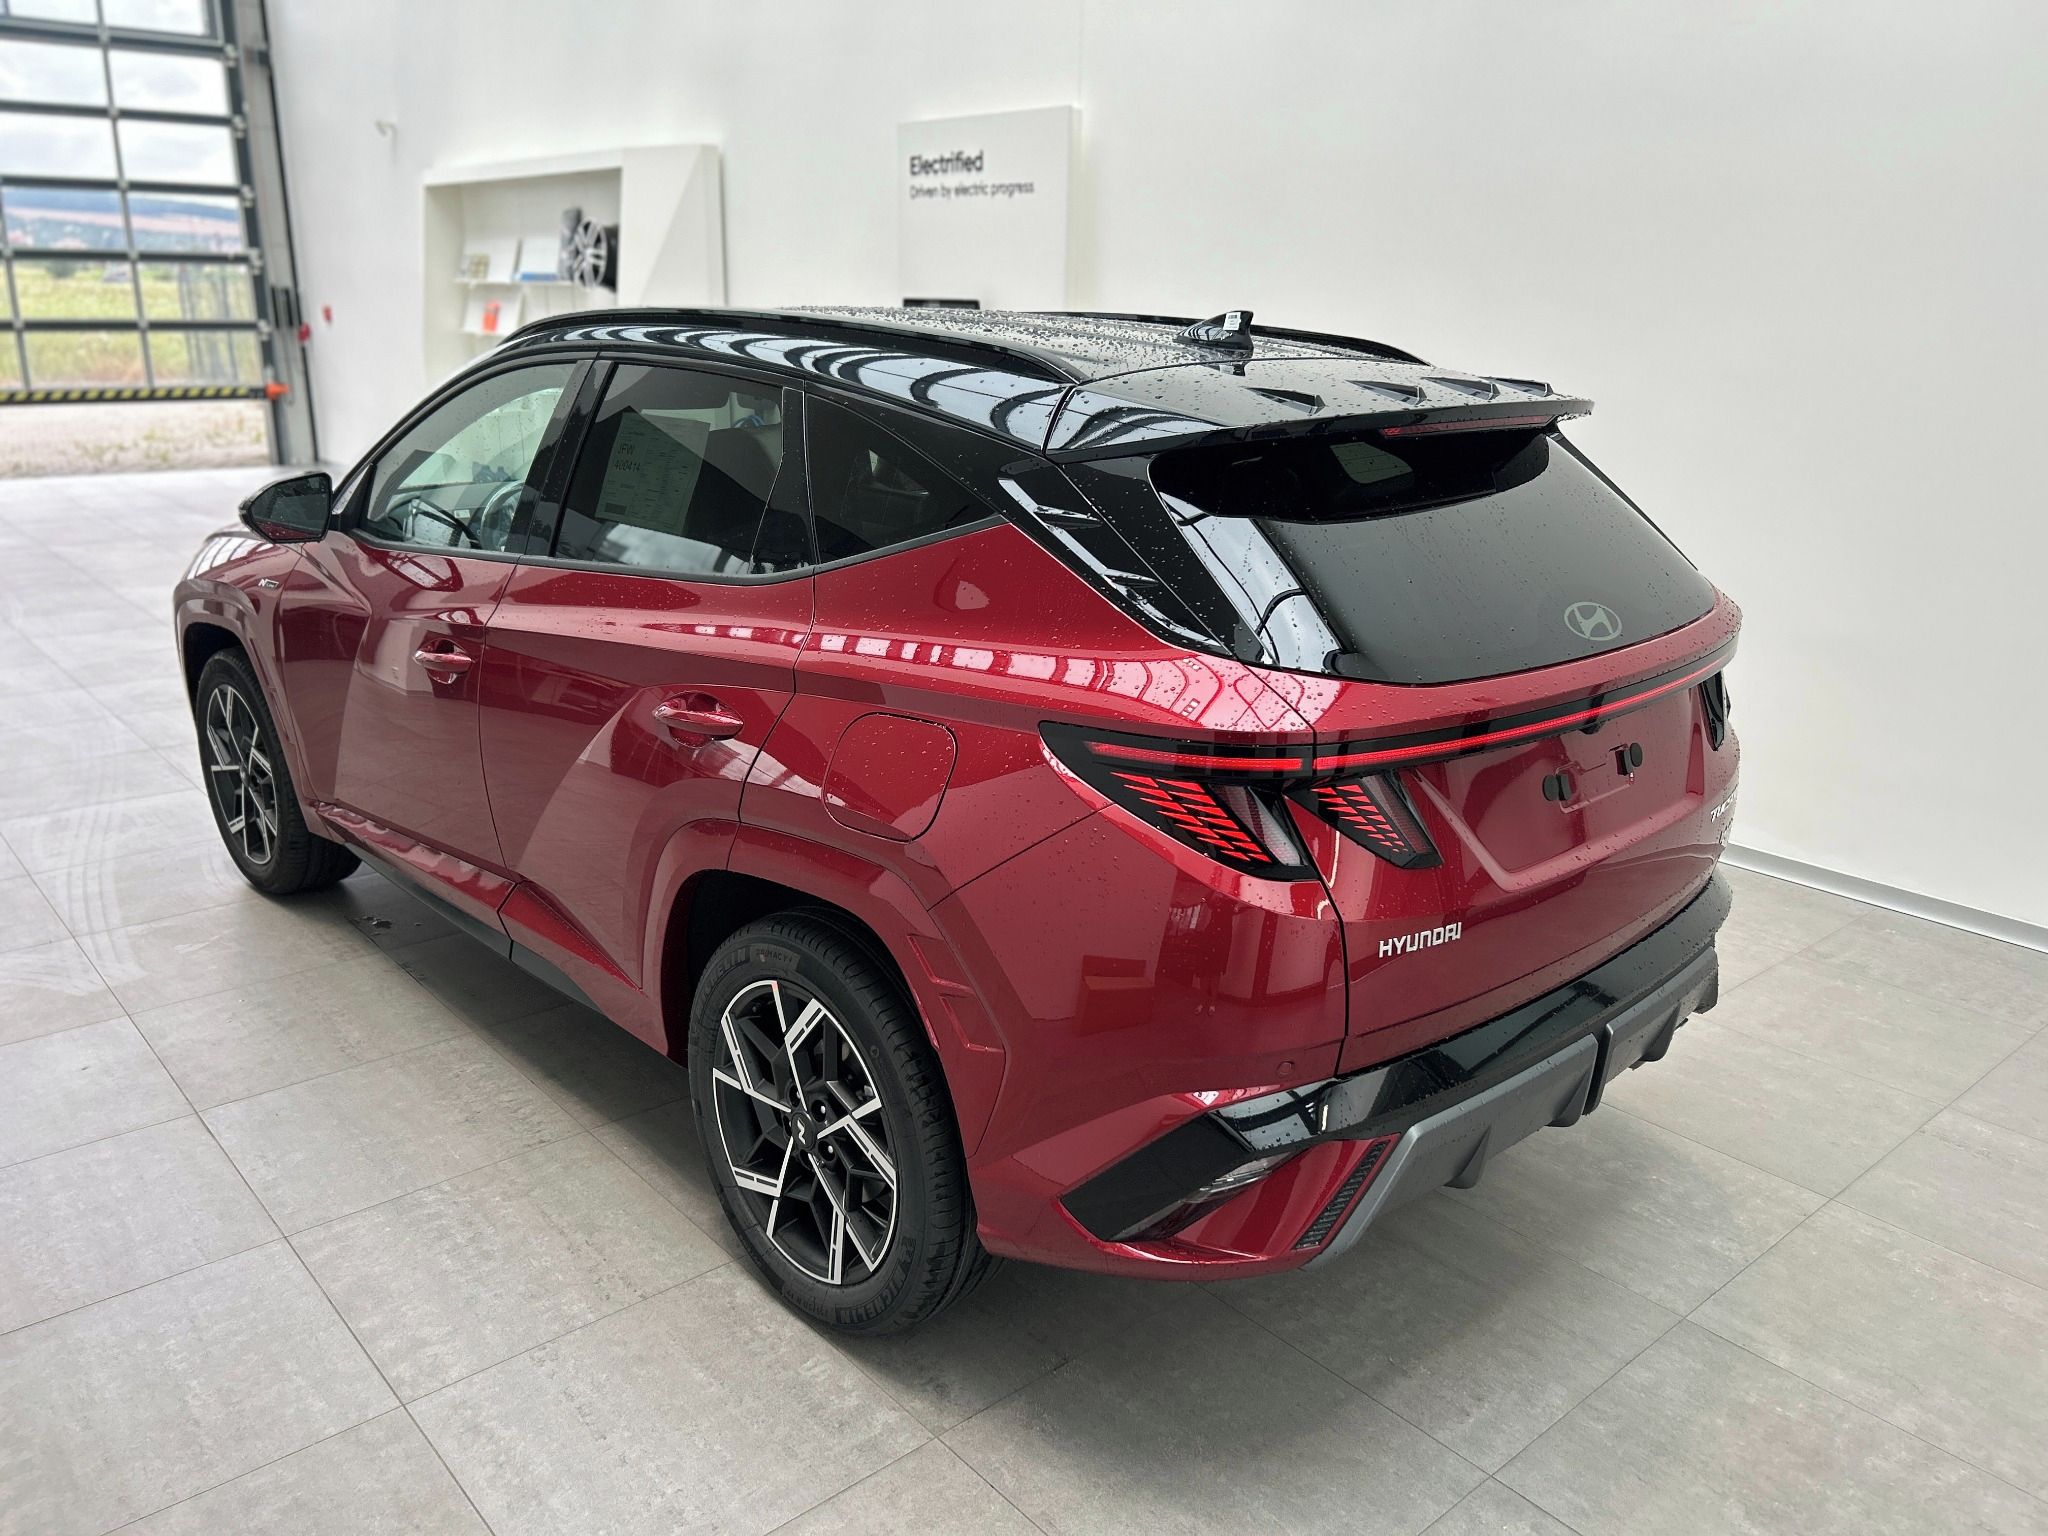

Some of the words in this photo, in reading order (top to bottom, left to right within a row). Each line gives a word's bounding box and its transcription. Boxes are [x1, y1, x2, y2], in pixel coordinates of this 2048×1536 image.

[910, 150, 983, 176] Electrified
[910, 185, 939, 199] Driven
[941, 184, 952, 199] by
[954, 181, 988, 197] electric
[991, 181, 1034, 198] progress
[1378, 922, 1462, 958] HYUNDAI
